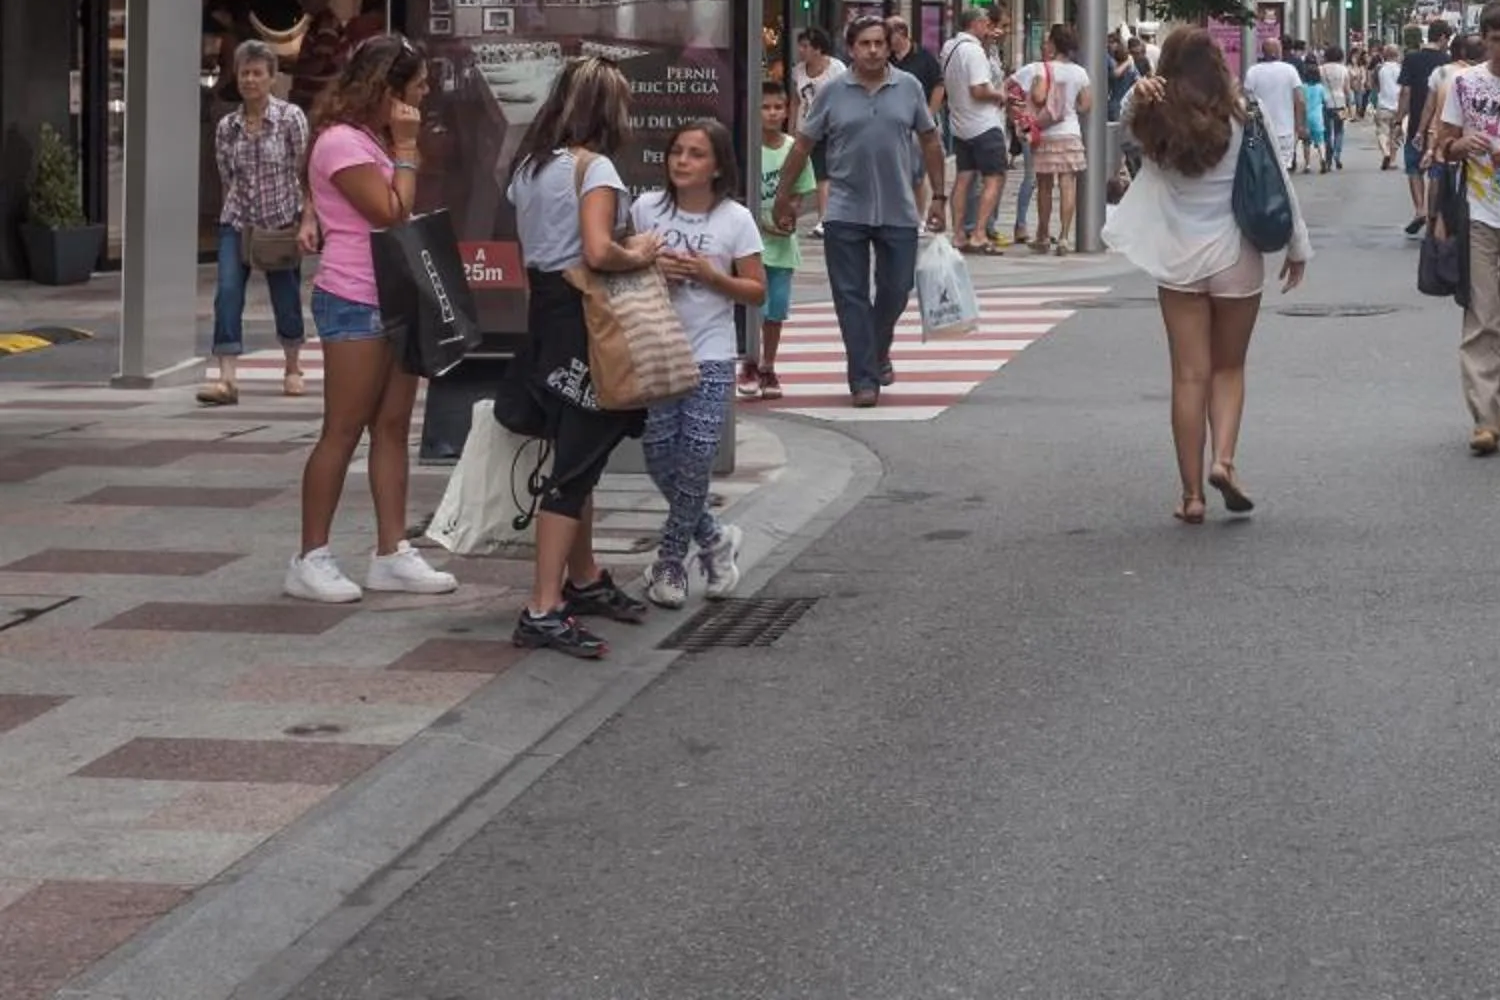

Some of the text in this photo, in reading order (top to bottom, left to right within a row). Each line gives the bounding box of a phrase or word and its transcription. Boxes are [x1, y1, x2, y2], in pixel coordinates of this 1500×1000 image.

[666, 65, 720, 81] PERNIL
[666, 81, 688, 94] DE
[654, 222, 714, 252] OVE
[475, 247, 487, 261] A
